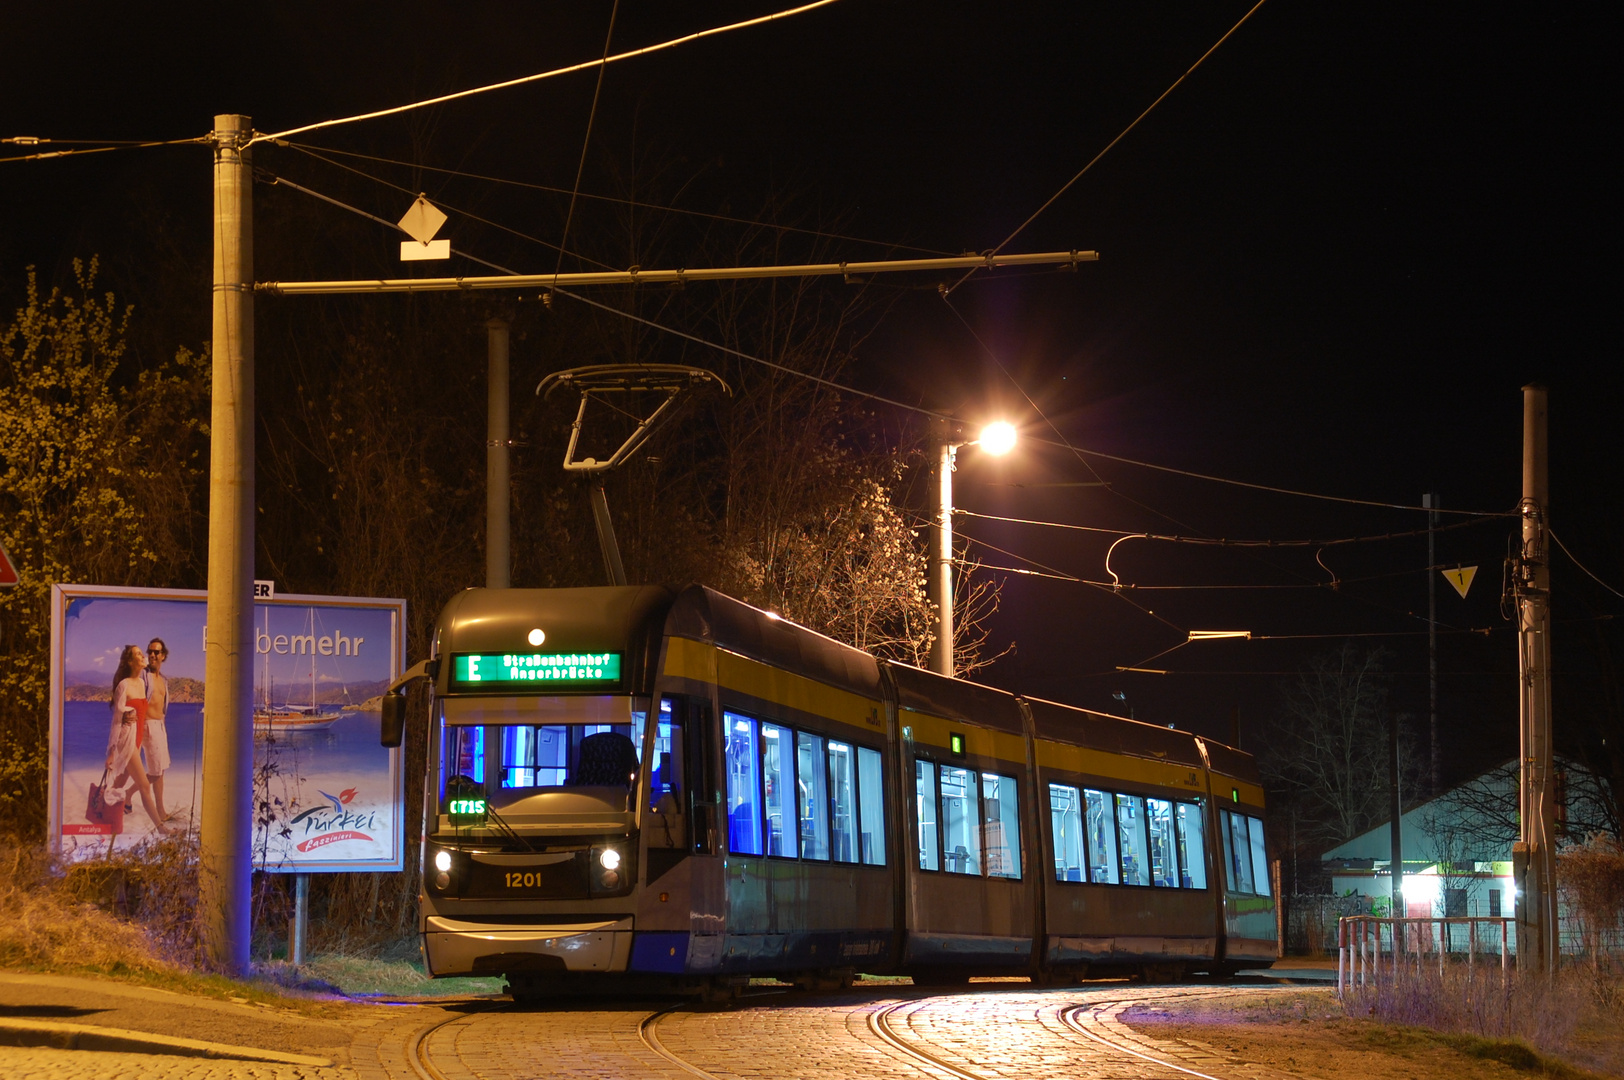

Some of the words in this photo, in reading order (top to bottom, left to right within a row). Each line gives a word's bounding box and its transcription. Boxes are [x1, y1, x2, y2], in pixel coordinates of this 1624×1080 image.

[1457, 573, 1464, 586] 1
[203, 625, 364, 656] bemehr
[503, 653, 610, 667] Straßenbahnhof
[468, 655, 481, 681] E
[510, 666, 602, 680] Angerbrücke
[291, 805, 376, 835] Türkei
[78, 826, 102, 834] Antalya
[505, 872, 542, 888] 1201
